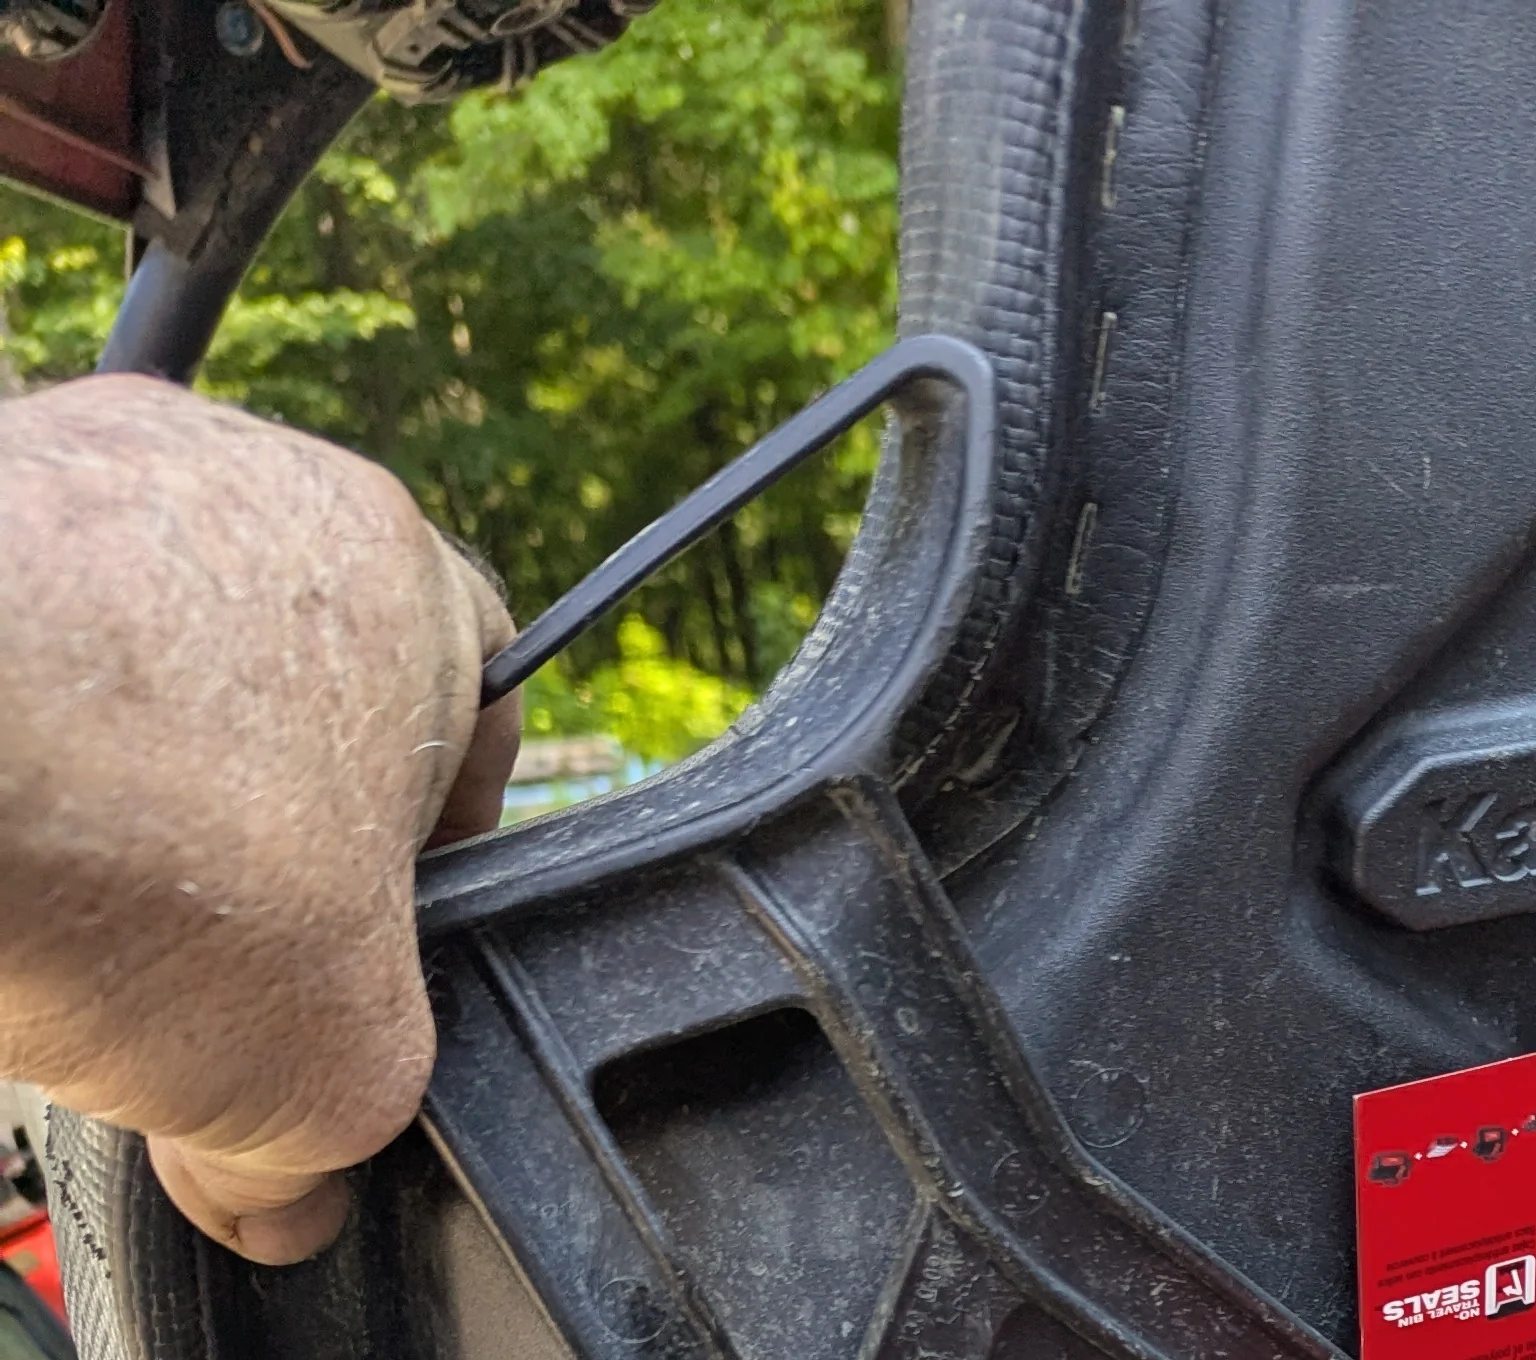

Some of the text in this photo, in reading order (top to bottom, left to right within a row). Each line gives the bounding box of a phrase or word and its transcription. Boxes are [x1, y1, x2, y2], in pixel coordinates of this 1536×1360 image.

[1382, 1280, 1480, 1322] SEALS
[1398, 1298, 1480, 1328] TRAVEL BIN
[1454, 1307, 1480, 1320] NO-
